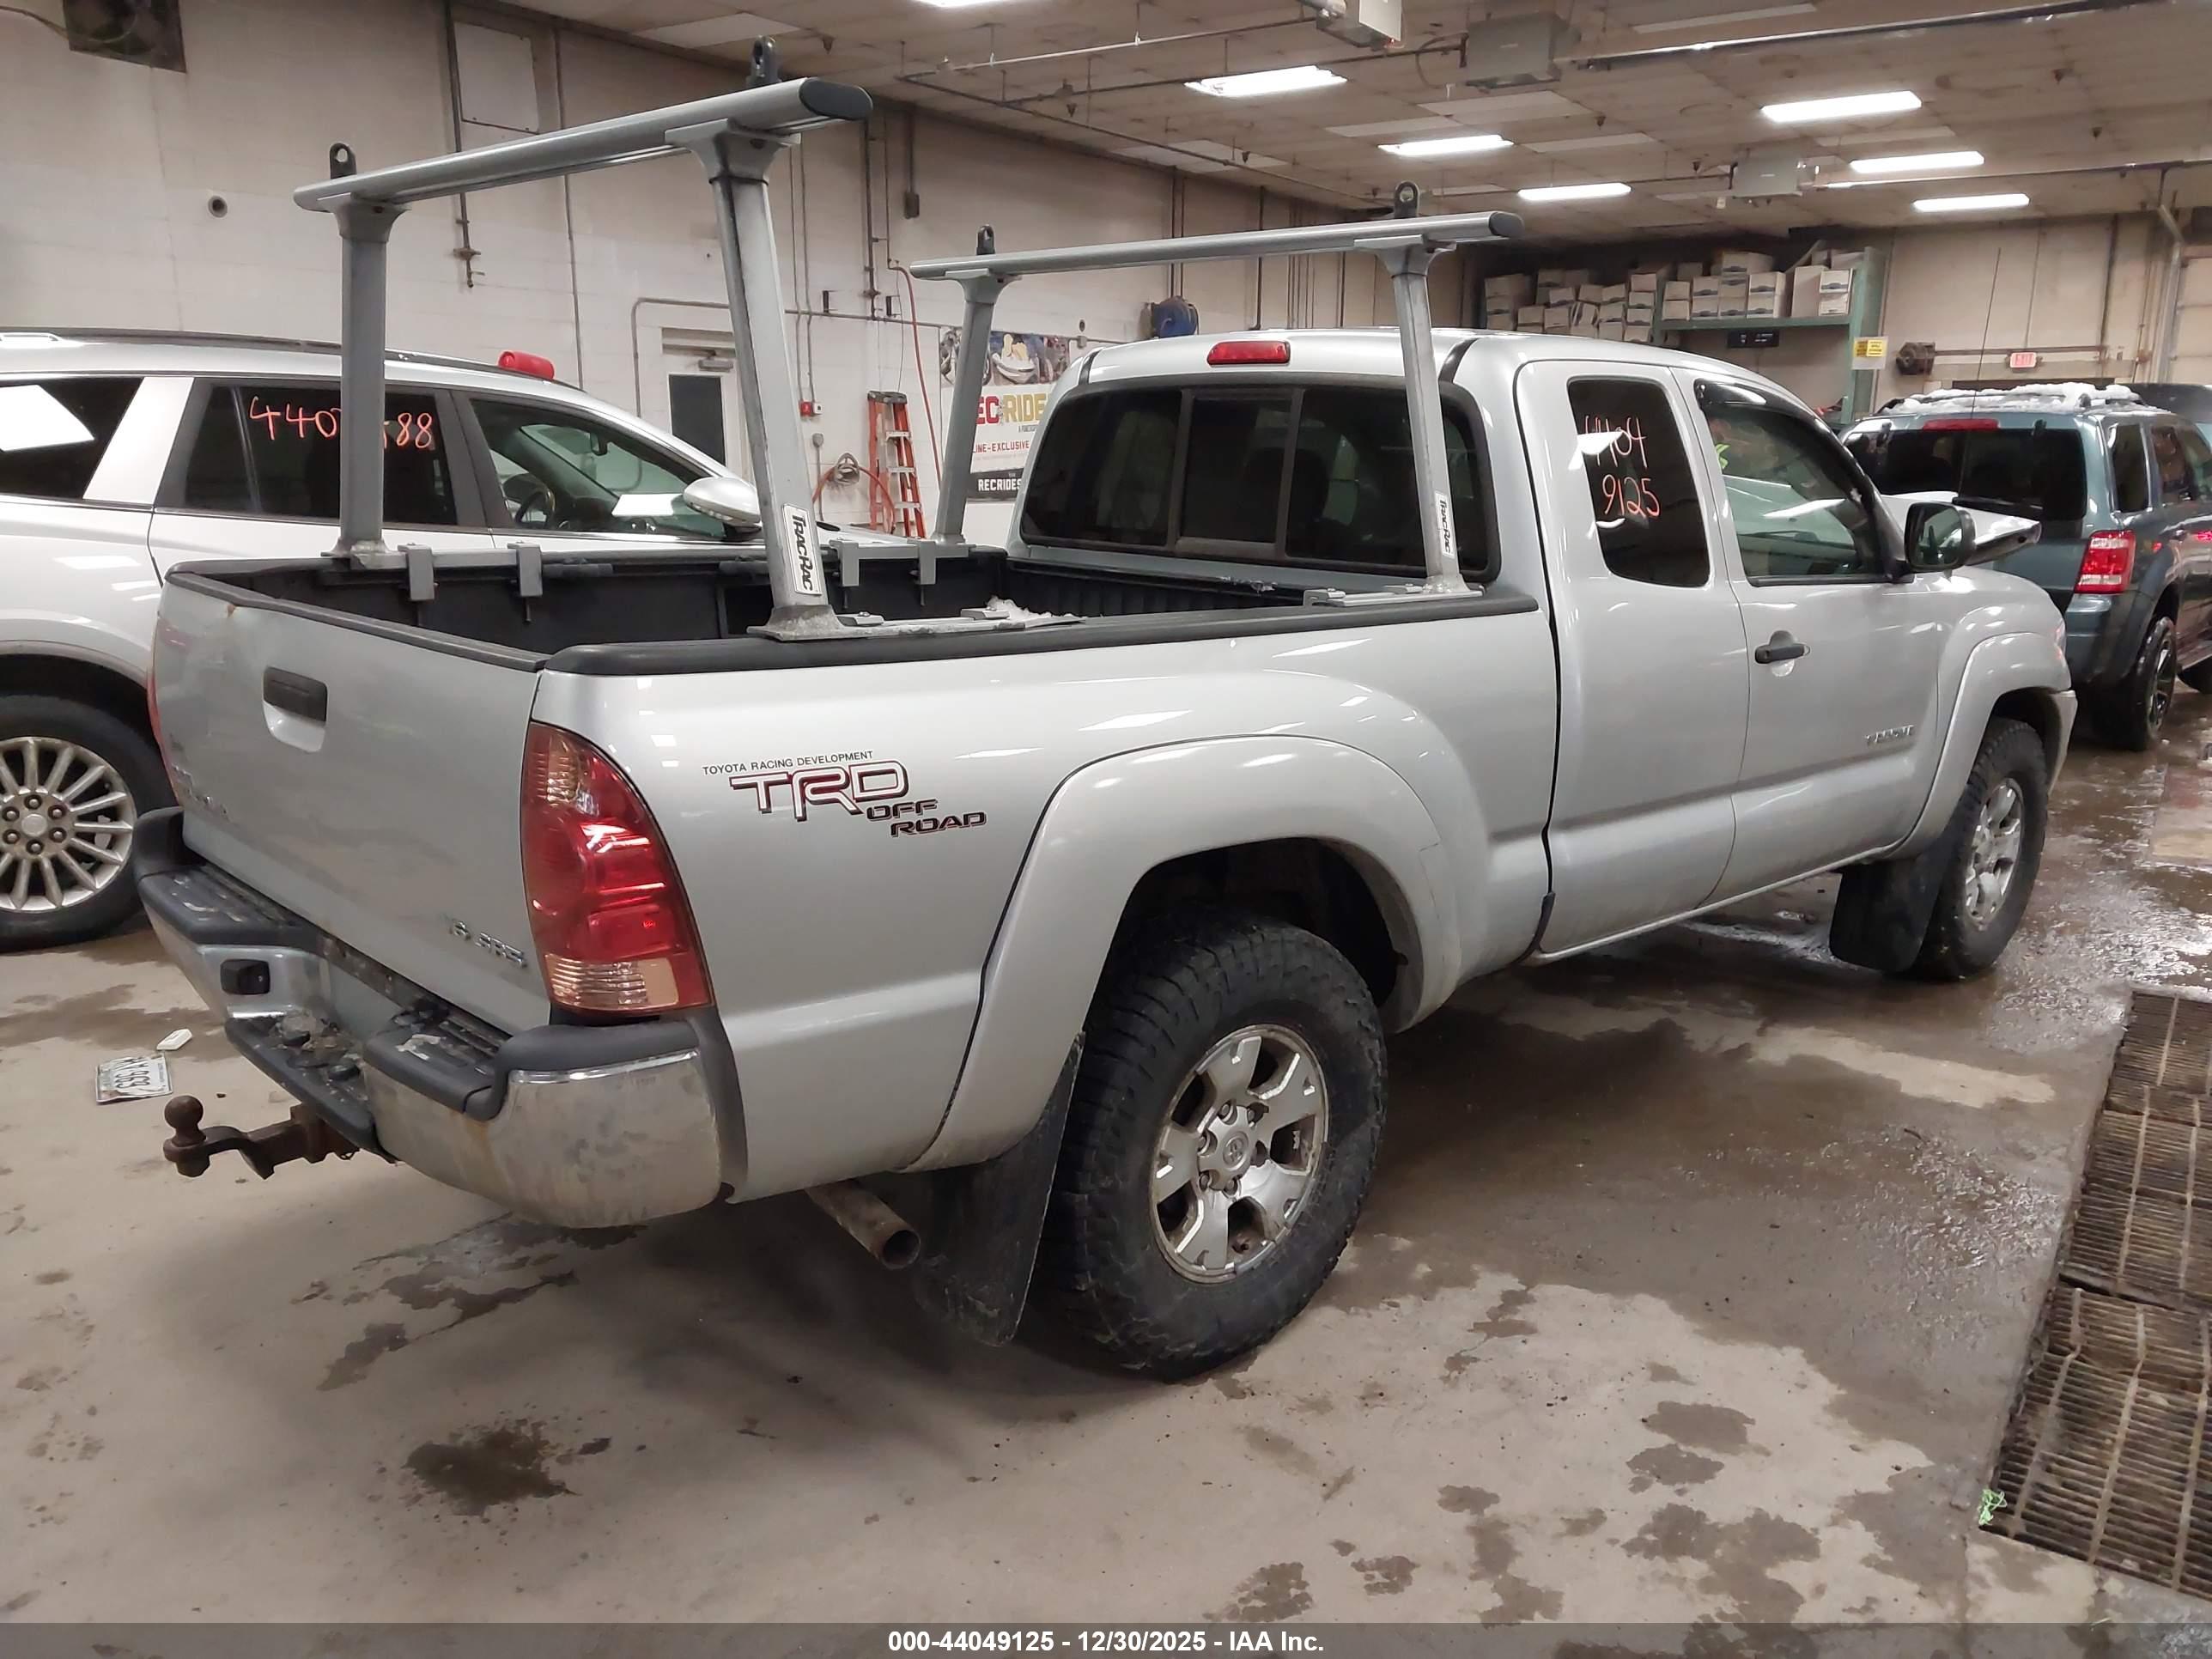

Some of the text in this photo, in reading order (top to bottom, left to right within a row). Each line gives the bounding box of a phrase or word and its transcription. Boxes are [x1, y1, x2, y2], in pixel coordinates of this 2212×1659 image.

[1602, 474, 1660, 519] 9125
[702, 750, 873, 775] TOYOTA RACING DEVELOPMENT
[729, 760, 909, 823] TRD
[866, 799, 939, 822] OFF
[890, 811, 988, 837] ROAD
